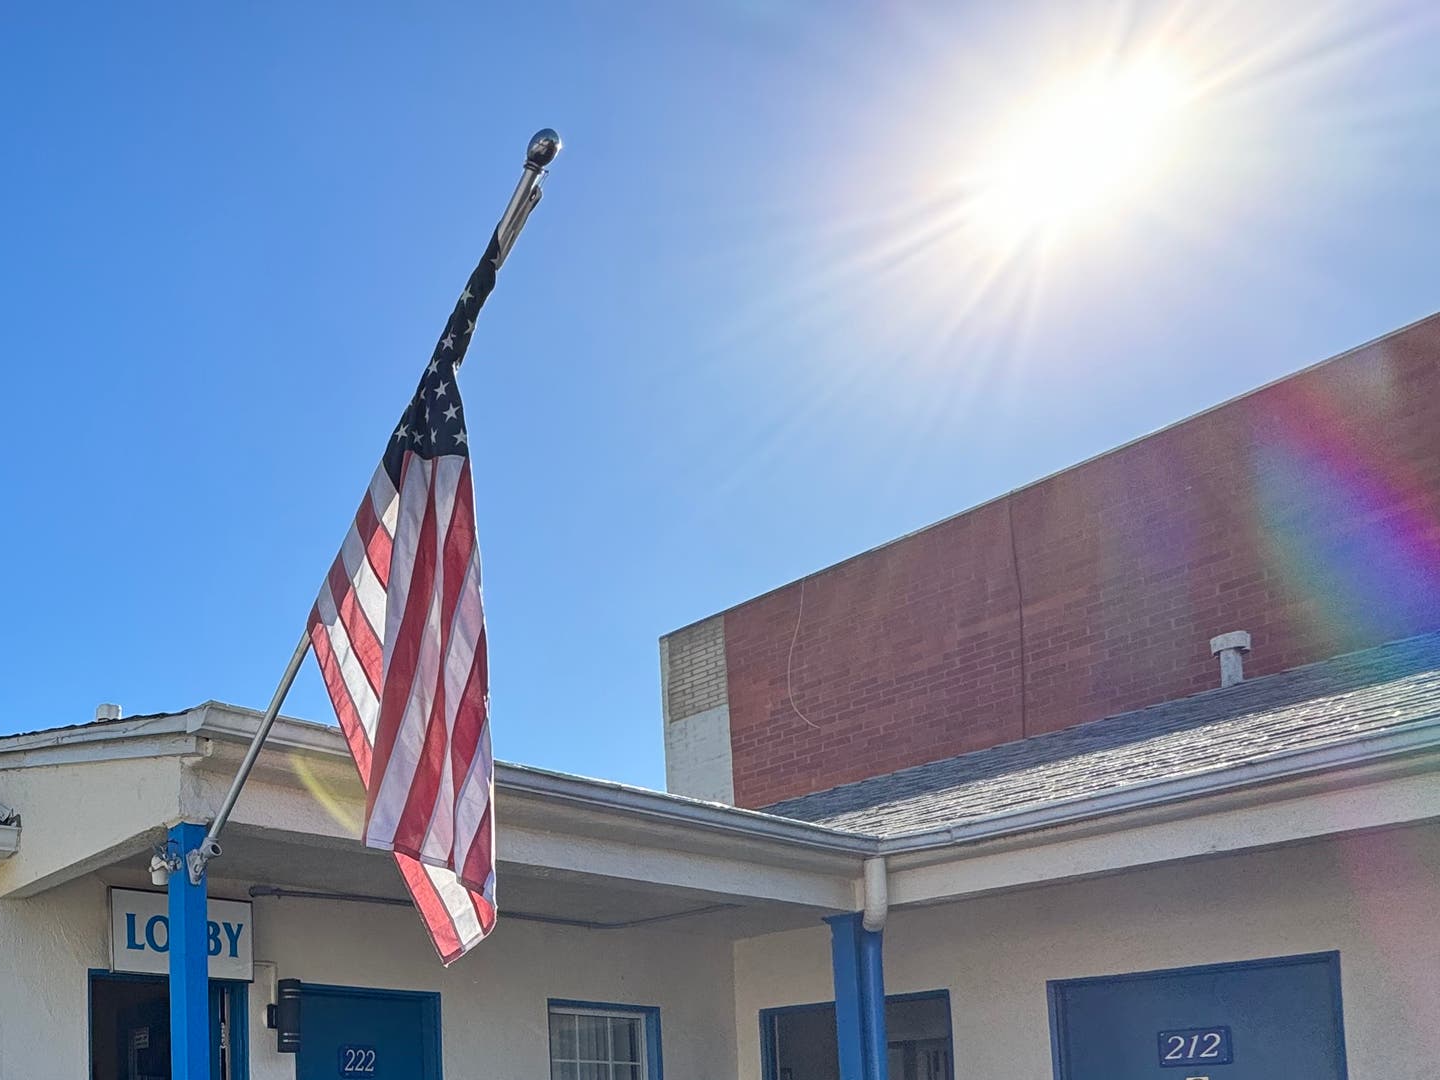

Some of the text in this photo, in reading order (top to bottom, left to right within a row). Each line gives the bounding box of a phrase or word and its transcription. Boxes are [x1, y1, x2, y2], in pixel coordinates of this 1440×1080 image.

[125, 912, 244, 958] LOBY
[344, 1049, 376, 1072] 222
[1164, 1032, 1222, 1061] 212
